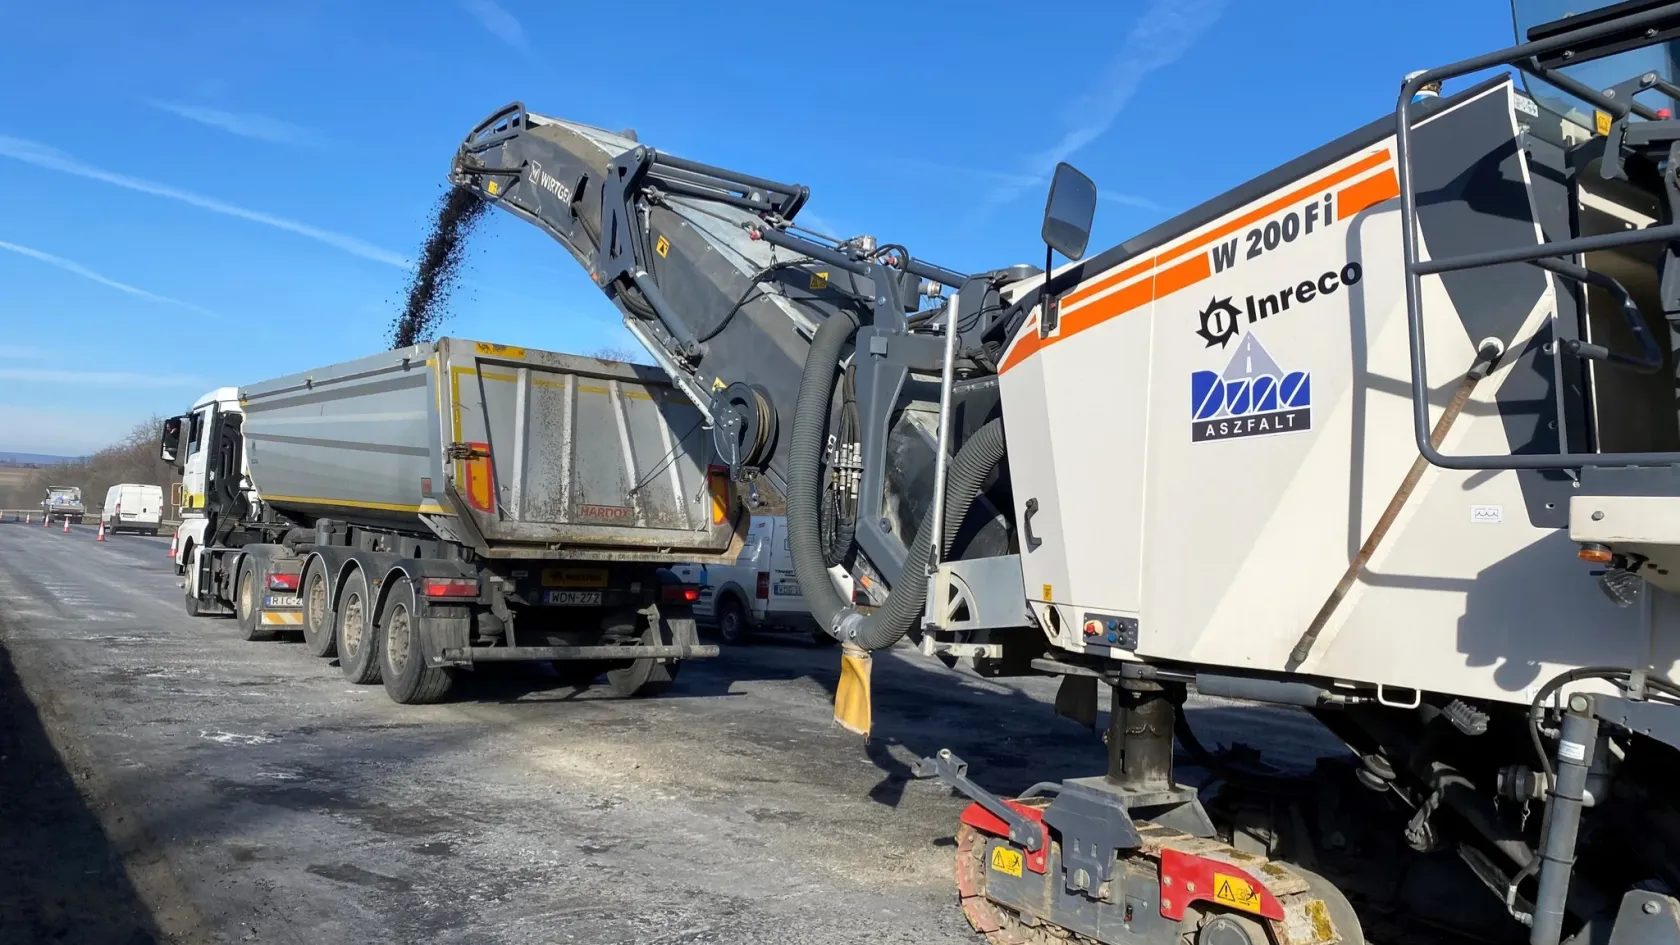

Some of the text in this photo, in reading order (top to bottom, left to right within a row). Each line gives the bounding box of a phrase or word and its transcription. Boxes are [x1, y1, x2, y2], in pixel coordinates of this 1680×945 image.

[1212, 238, 1238, 274] W
[1246, 212, 1300, 260] 200
[1245, 262, 1363, 324] Inreco
[1205, 414, 1296, 437] ASZFALT
[581, 506, 632, 517] HARDOX
[272, 596, 303, 605] RIC-2
[551, 592, 600, 603] WDN-272
